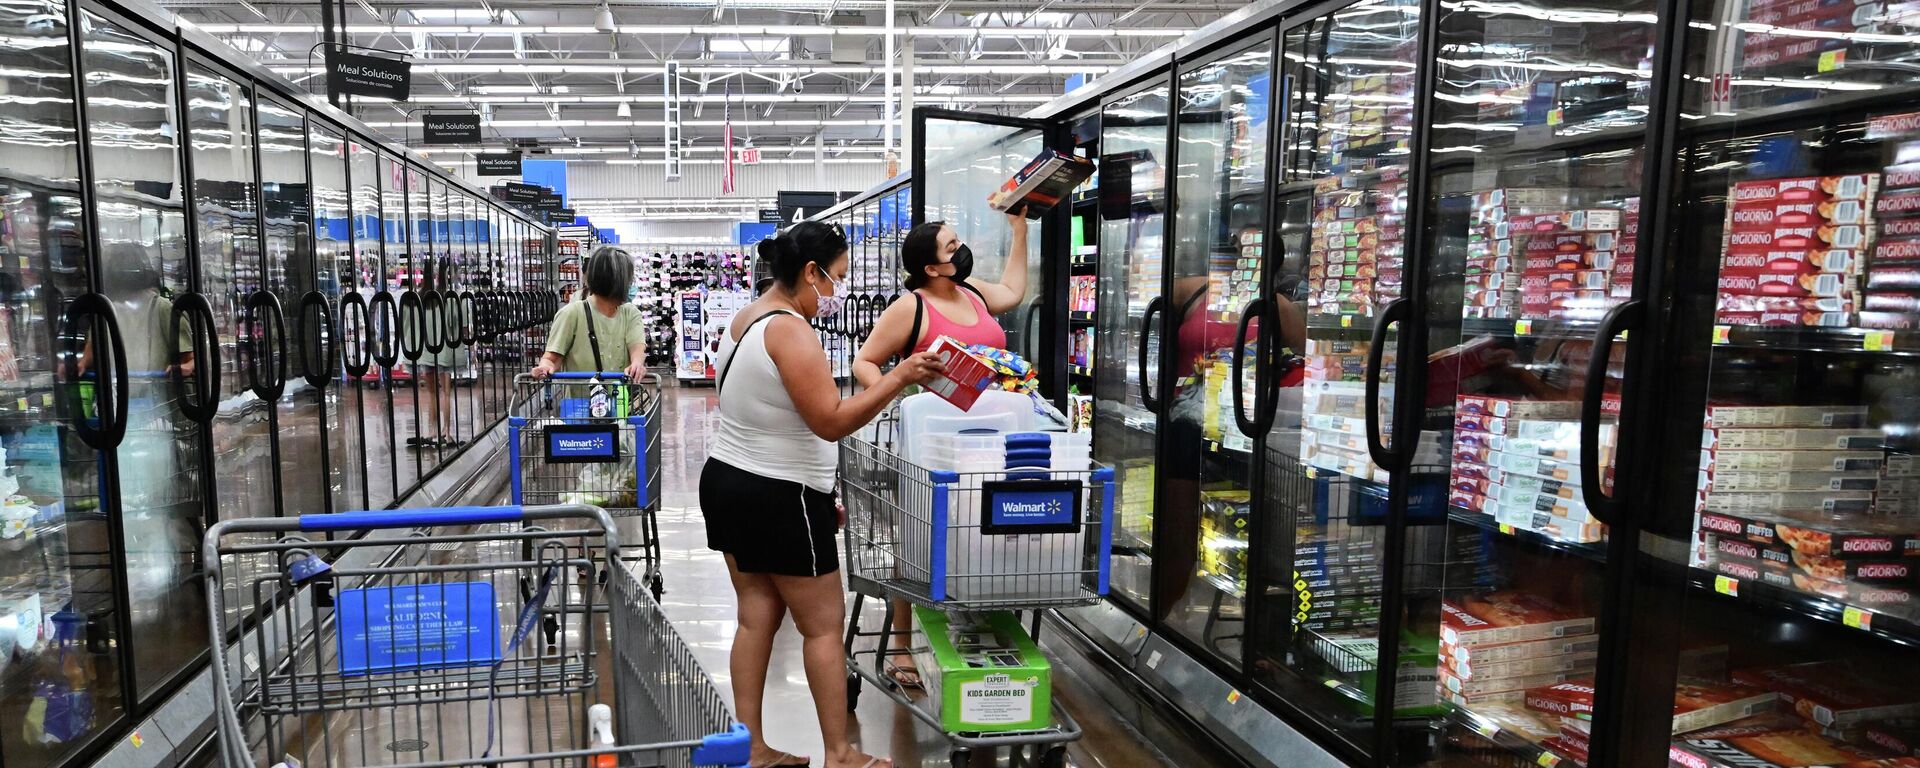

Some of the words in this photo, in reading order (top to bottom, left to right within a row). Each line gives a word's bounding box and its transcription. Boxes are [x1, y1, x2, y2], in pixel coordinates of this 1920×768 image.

[337, 63, 359, 75] Meal
[362, 67, 403, 81] Solutions
[445, 122, 475, 130] Solutions
[742, 150, 758, 163] EXIT
[1737, 187, 1776, 199] DIGIORNO
[791, 207, 804, 223] 4
[1734, 211, 1773, 222] DIGIORNO
[1731, 233, 1771, 245] DIGIORNO
[1726, 256, 1765, 267] DIGIORNO
[1718, 278, 1756, 289] DIGIORNO
[559, 440, 592, 448] Walmart
[1002, 502, 1046, 513] Walmart
[1702, 517, 1741, 533] DIGIORNO
[1746, 524, 1773, 537] STUFFED
[1719, 540, 1757, 559] DIGIORNO
[1762, 549, 1789, 563] STUFFED
[1843, 541, 1893, 552] DIGIORNO
[1720, 563, 1758, 579] DIGIORNO
[1764, 571, 1791, 585] STUFFED
[1857, 567, 1907, 577] DIGIORNO
[1860, 592, 1910, 602] DIGIORNO
[370, 624, 404, 632] SHOPPNG
[406, 622, 424, 630] CAT
[984, 689, 1011, 697] GARDEN
[1527, 697, 1568, 713] DIGIORNO
